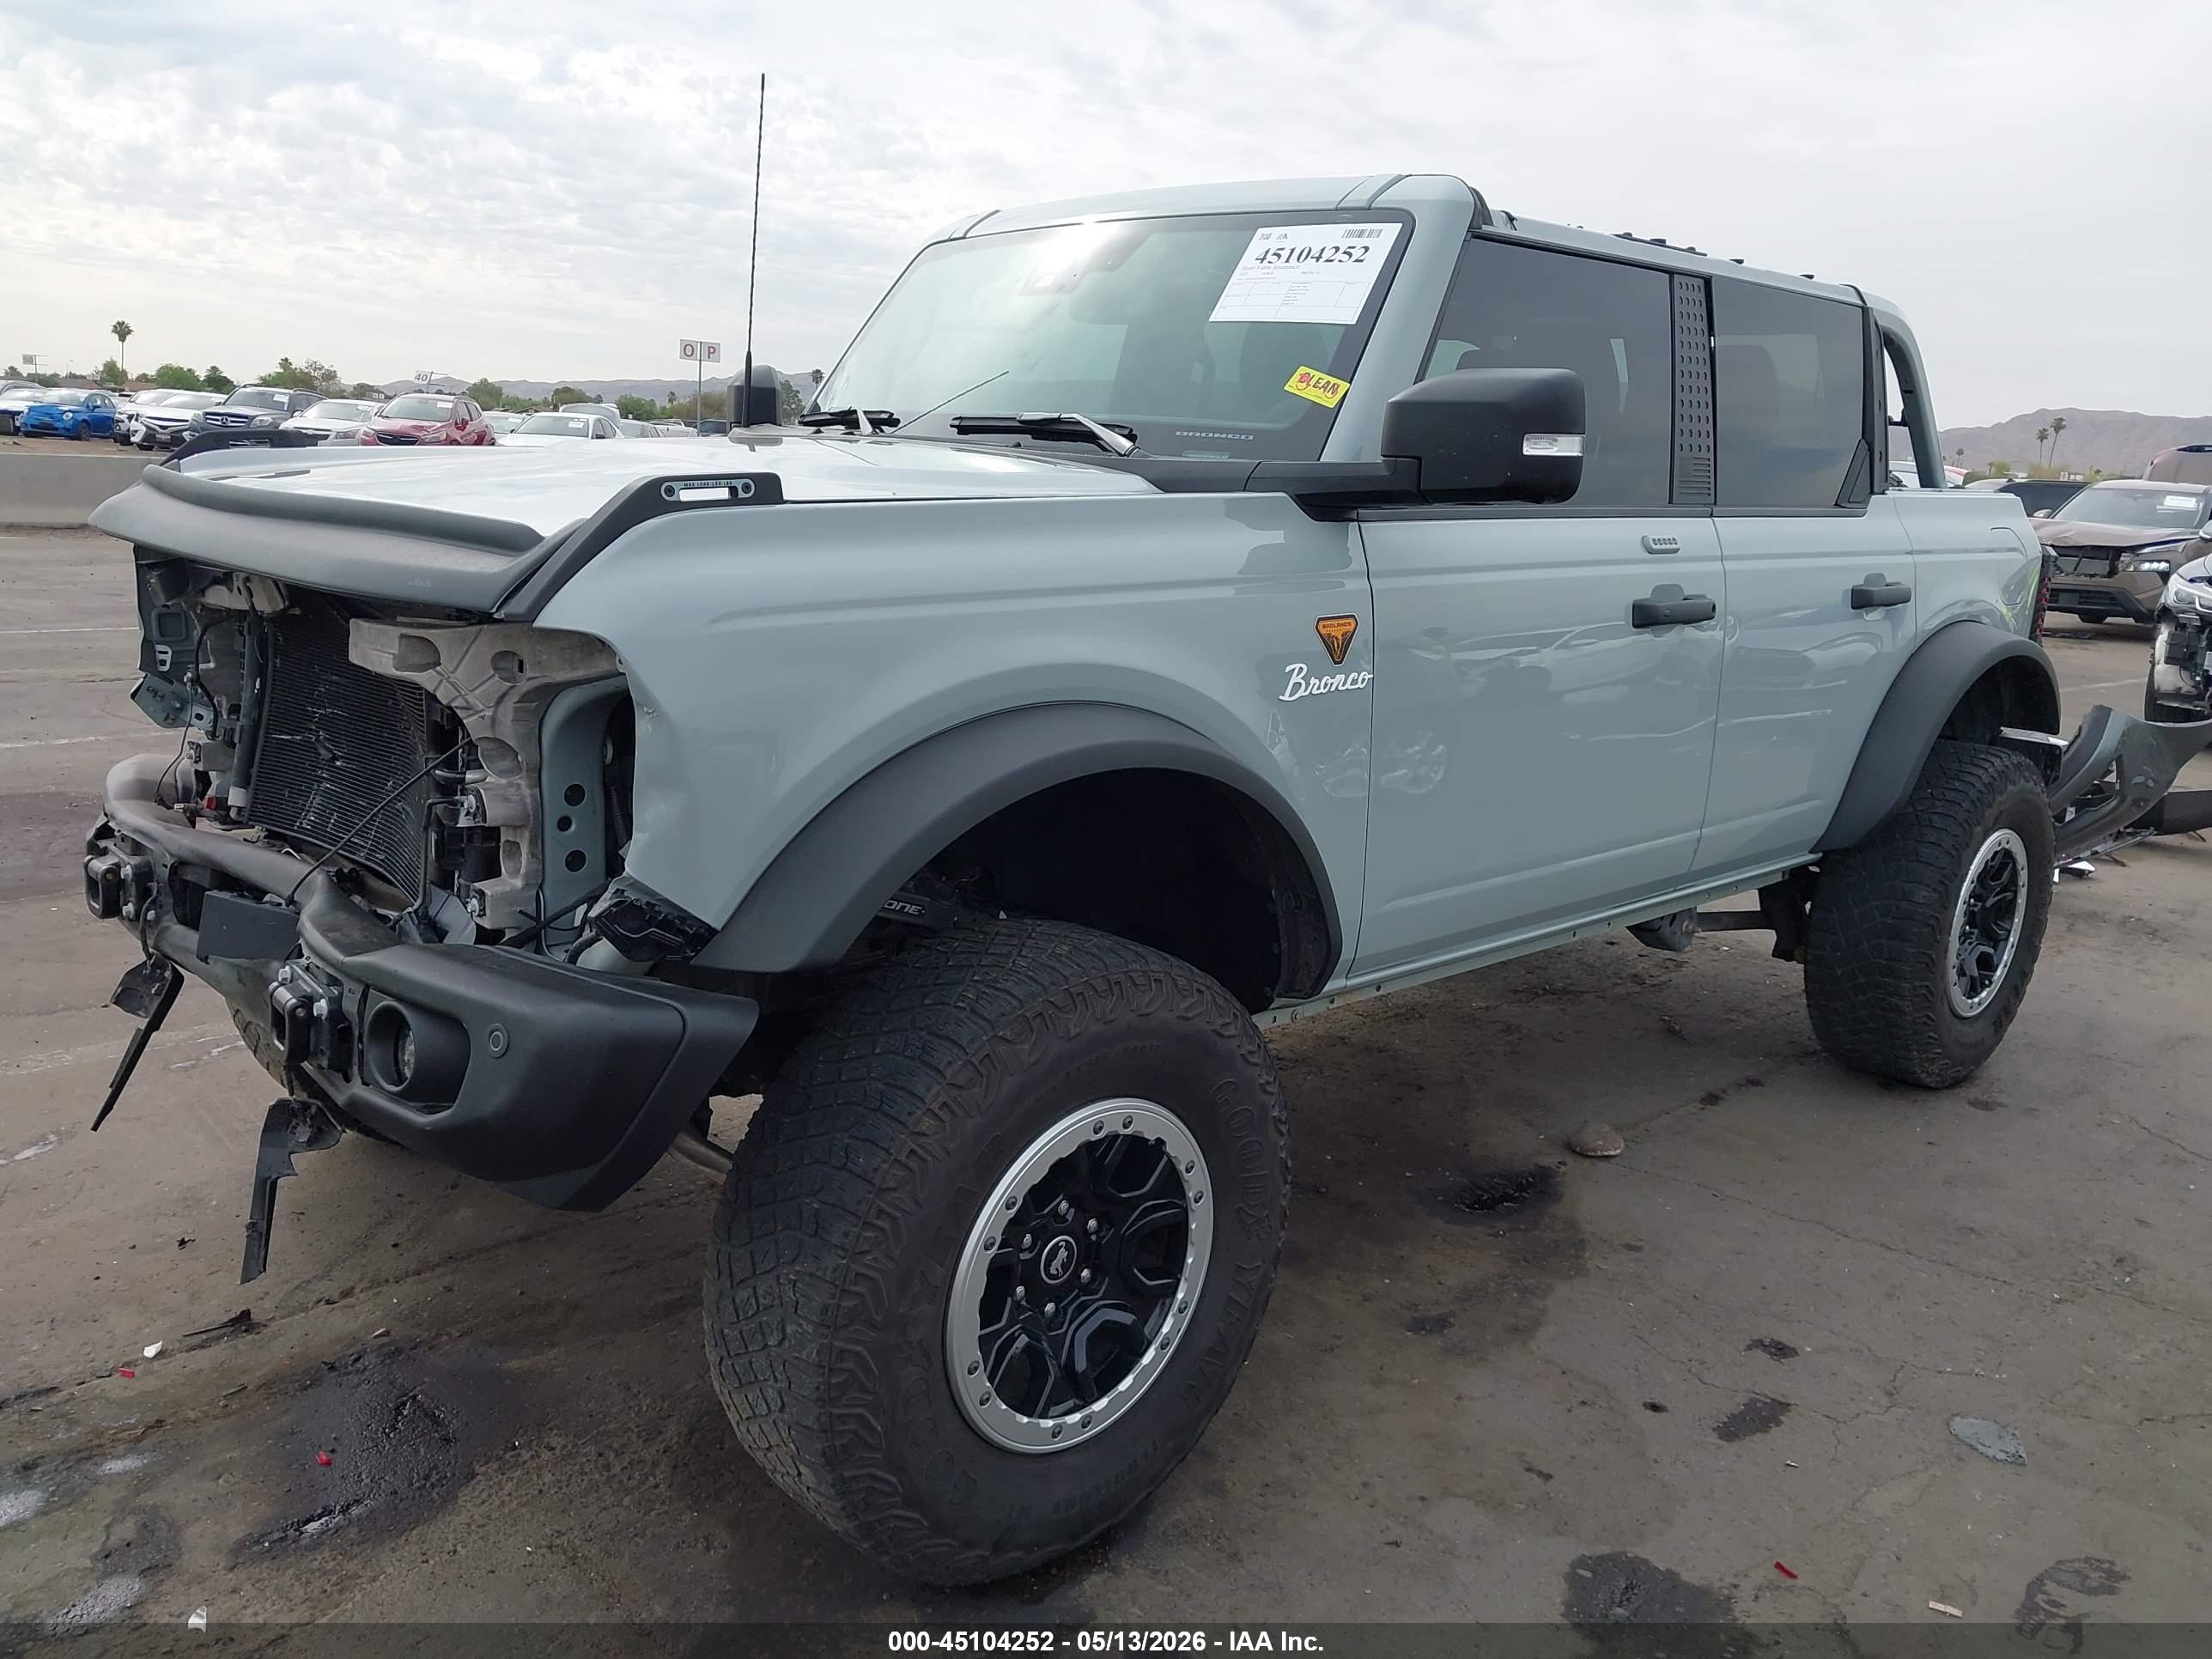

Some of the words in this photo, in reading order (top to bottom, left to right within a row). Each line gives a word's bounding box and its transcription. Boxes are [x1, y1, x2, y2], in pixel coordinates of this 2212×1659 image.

[1255, 245, 1370, 264] 45104252
[683, 343, 695, 358] O
[707, 345, 716, 360] P
[414, 373, 428, 382] 40
[1175, 430, 1255, 441] BRONCO
[1278, 663, 1374, 702] Bronco
